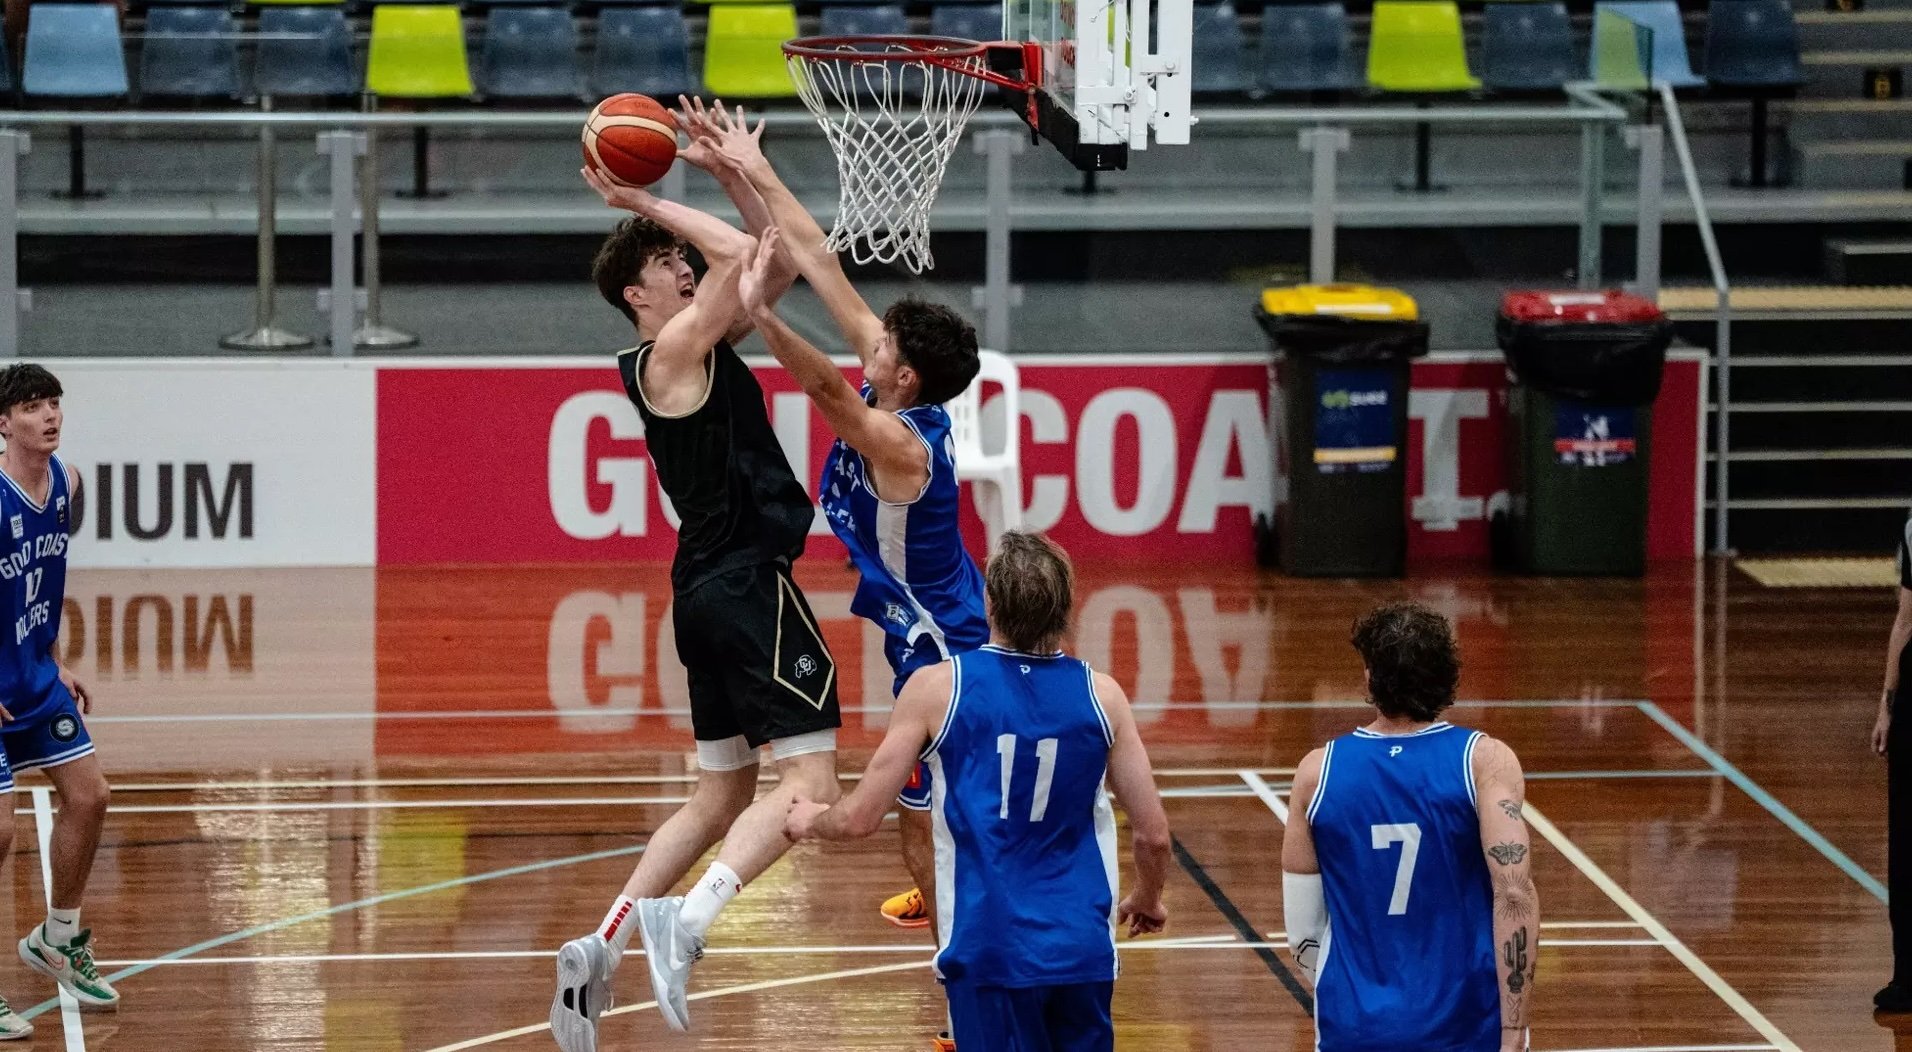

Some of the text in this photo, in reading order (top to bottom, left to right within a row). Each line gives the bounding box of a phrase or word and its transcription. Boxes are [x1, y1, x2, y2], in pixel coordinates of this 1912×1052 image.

[975, 387, 1490, 536] COAT
[996, 733, 1059, 823] 11
[1370, 822, 1422, 916] 7
